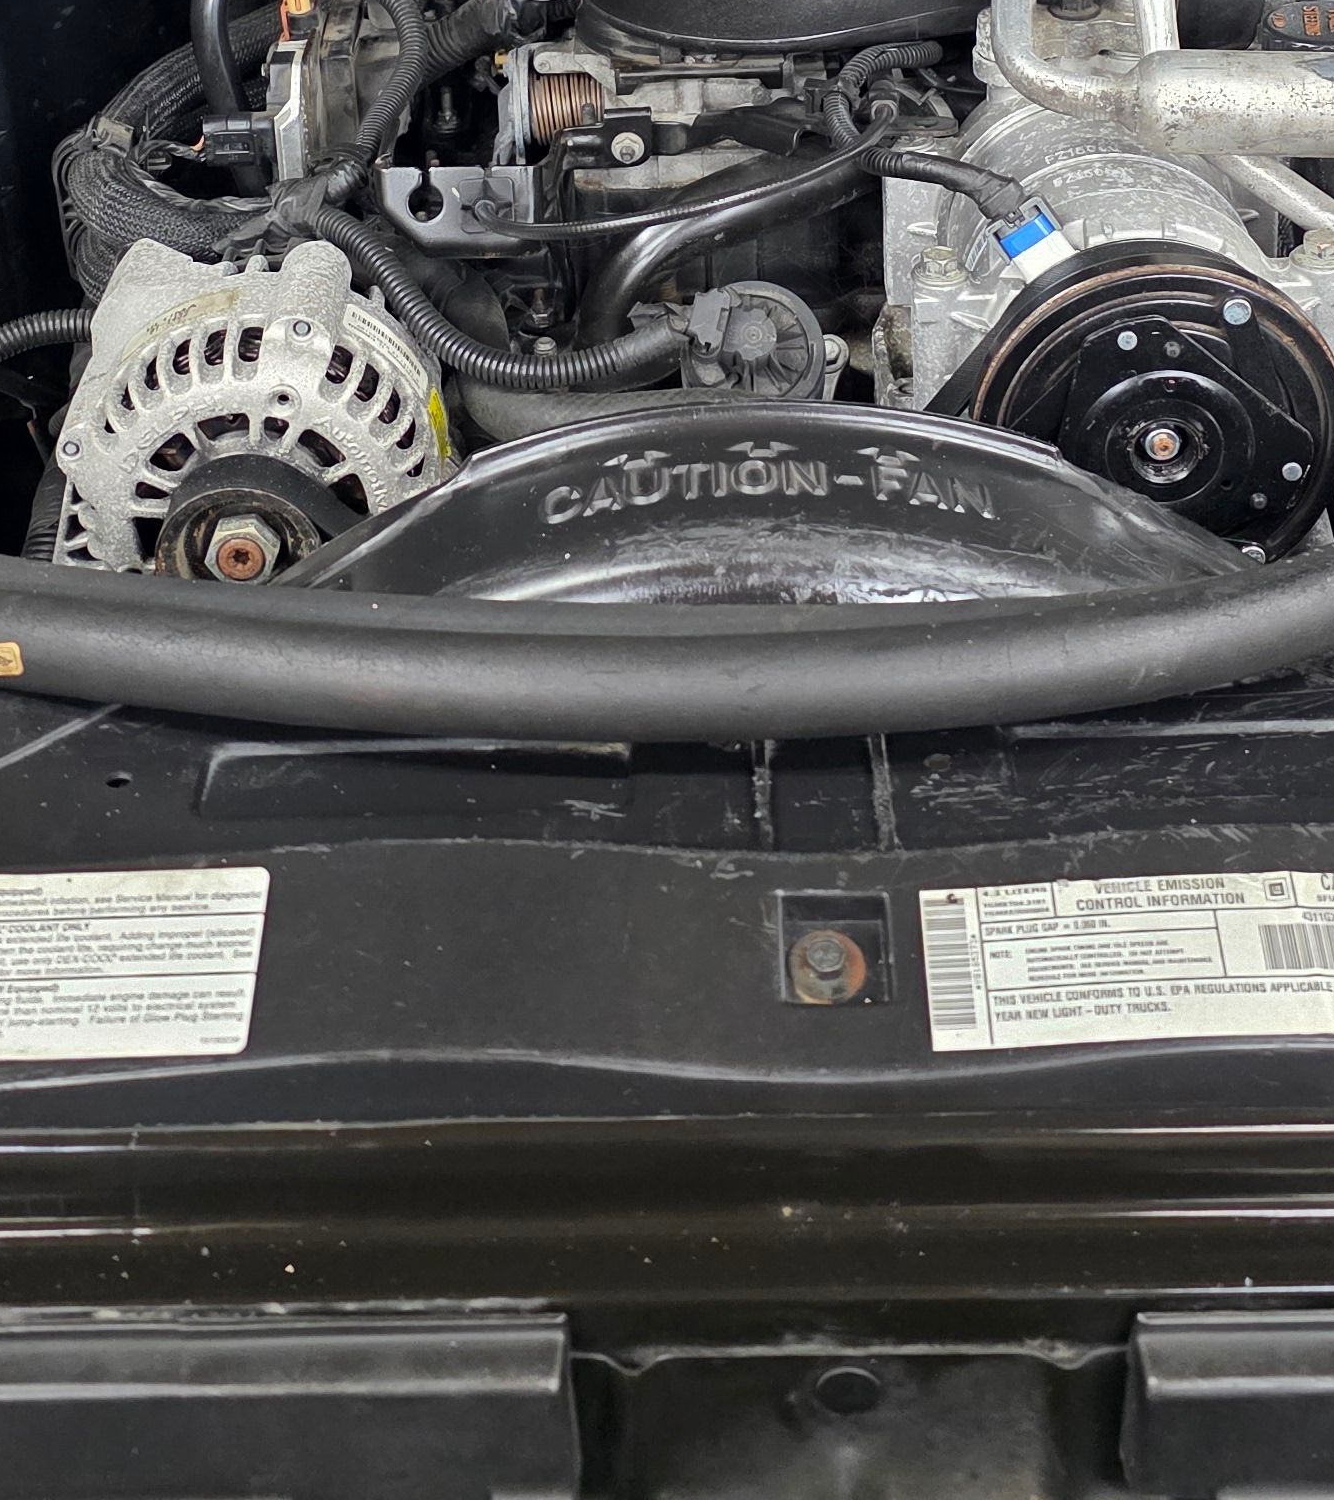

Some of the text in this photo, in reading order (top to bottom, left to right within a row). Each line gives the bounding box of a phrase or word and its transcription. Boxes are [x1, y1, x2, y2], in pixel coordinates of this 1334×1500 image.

[1302, 4, 1322, 37] STEERING
[1094, 876, 1226, 895] VEHICLE EMISSION
[1076, 891, 1246, 912] CONTROL INFORMATION
[984, 924, 1014, 937] SPARK
[1016, 922, 1040, 934] PLUG
[1042, 921, 1060, 933] GAP
[993, 994, 1017, 1006] THIS
[1020, 991, 1062, 1005] VEHICLE
[1066, 988, 1124, 1002] CONFORMS
[1127, 987, 1141, 998] TO
[1144, 985, 1166, 997] U.S.
[1170, 983, 1191, 996] EPA
[1194, 981, 1267, 994] REGULATIONS
[1269, 981, 1333, 993] APPLICABLE
[994, 1010, 1022, 1023] YEAR
[1025, 1008, 1049, 1020] NEW
[1126, 1001, 1172, 1014] TRUCKS.
